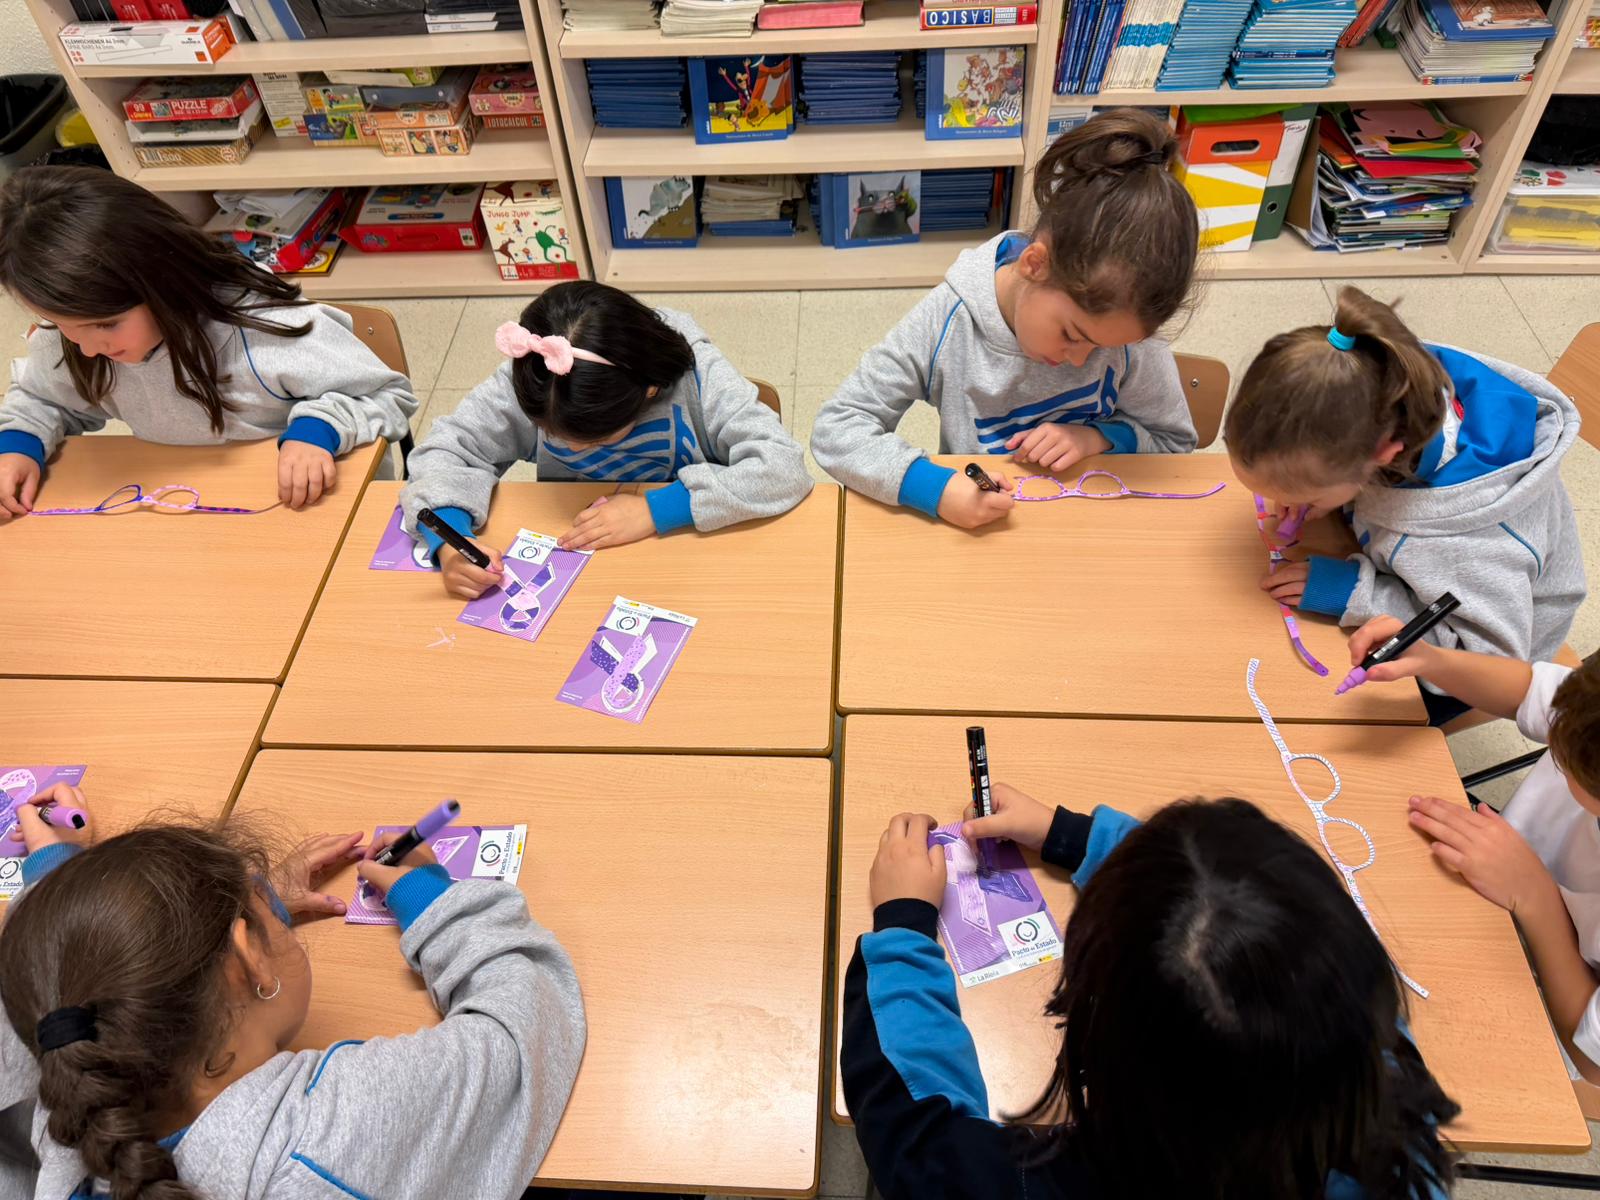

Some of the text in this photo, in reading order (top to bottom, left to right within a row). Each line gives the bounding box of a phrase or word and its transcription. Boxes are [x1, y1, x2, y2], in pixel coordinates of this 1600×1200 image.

[929, 9, 992, 26] BÁSICO
[171, 99, 208, 110] PUZZLE
[498, 858, 508, 875] Pacto
[504, 831, 513, 853] Estado
[1011, 946, 1030, 957] Pacto
[1035, 938, 1057, 950] Estado
